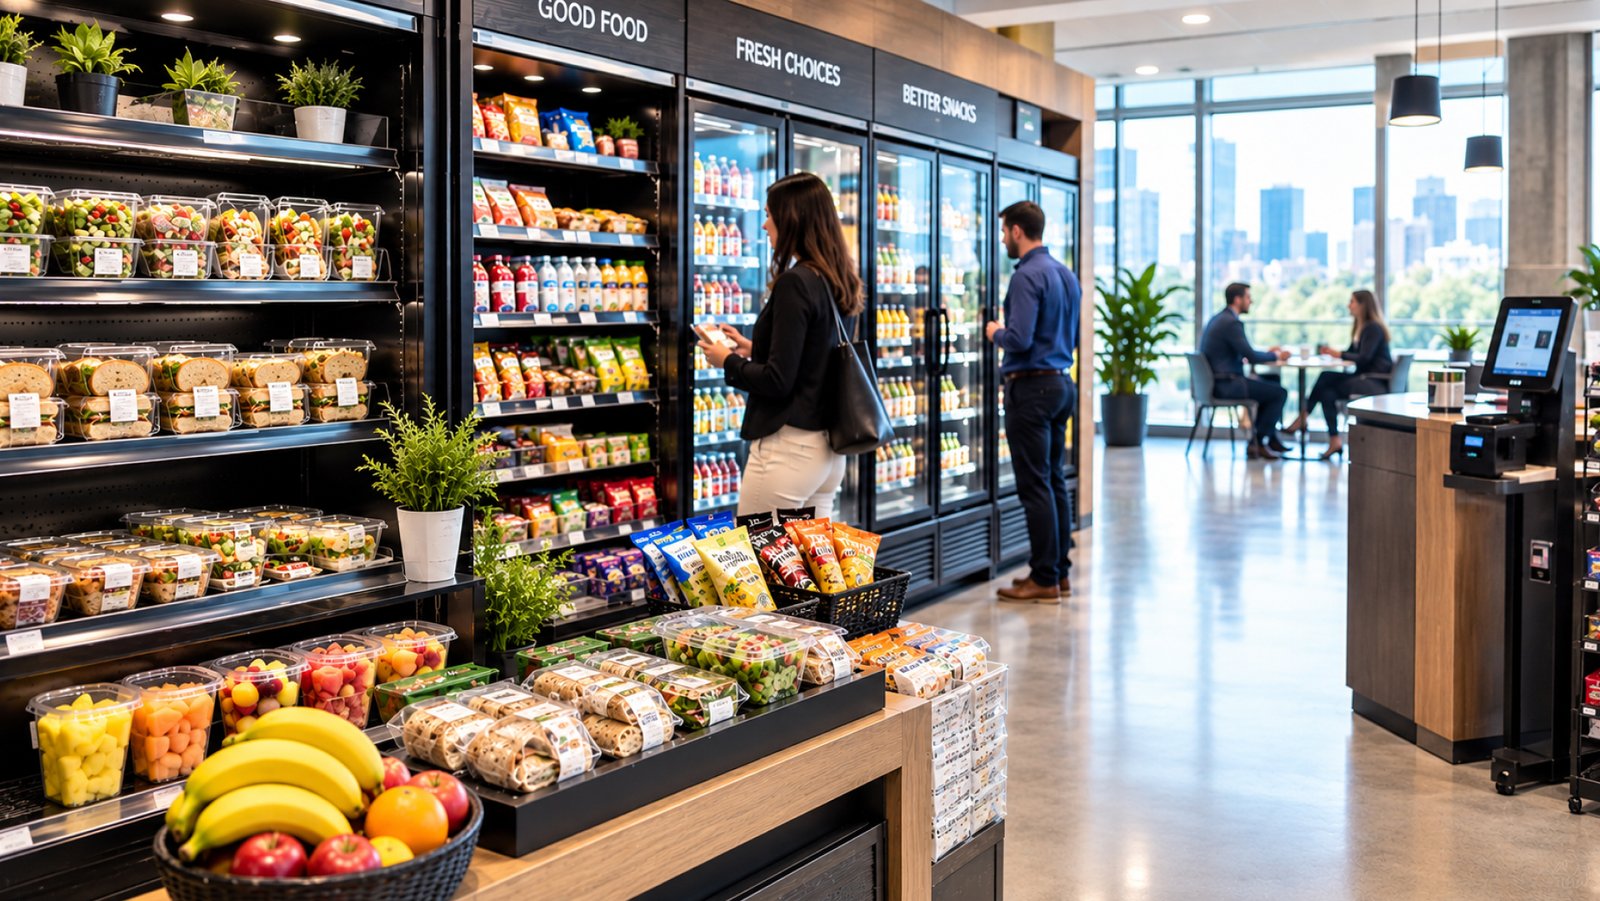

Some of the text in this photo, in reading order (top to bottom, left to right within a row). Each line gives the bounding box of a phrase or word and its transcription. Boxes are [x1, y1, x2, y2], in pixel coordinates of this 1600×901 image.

[538, 0, 648, 42] GOOD FOOD
[736, 36, 841, 87] FRESH CHOICES
[903, 84, 977, 124] BETTER SNACKS
